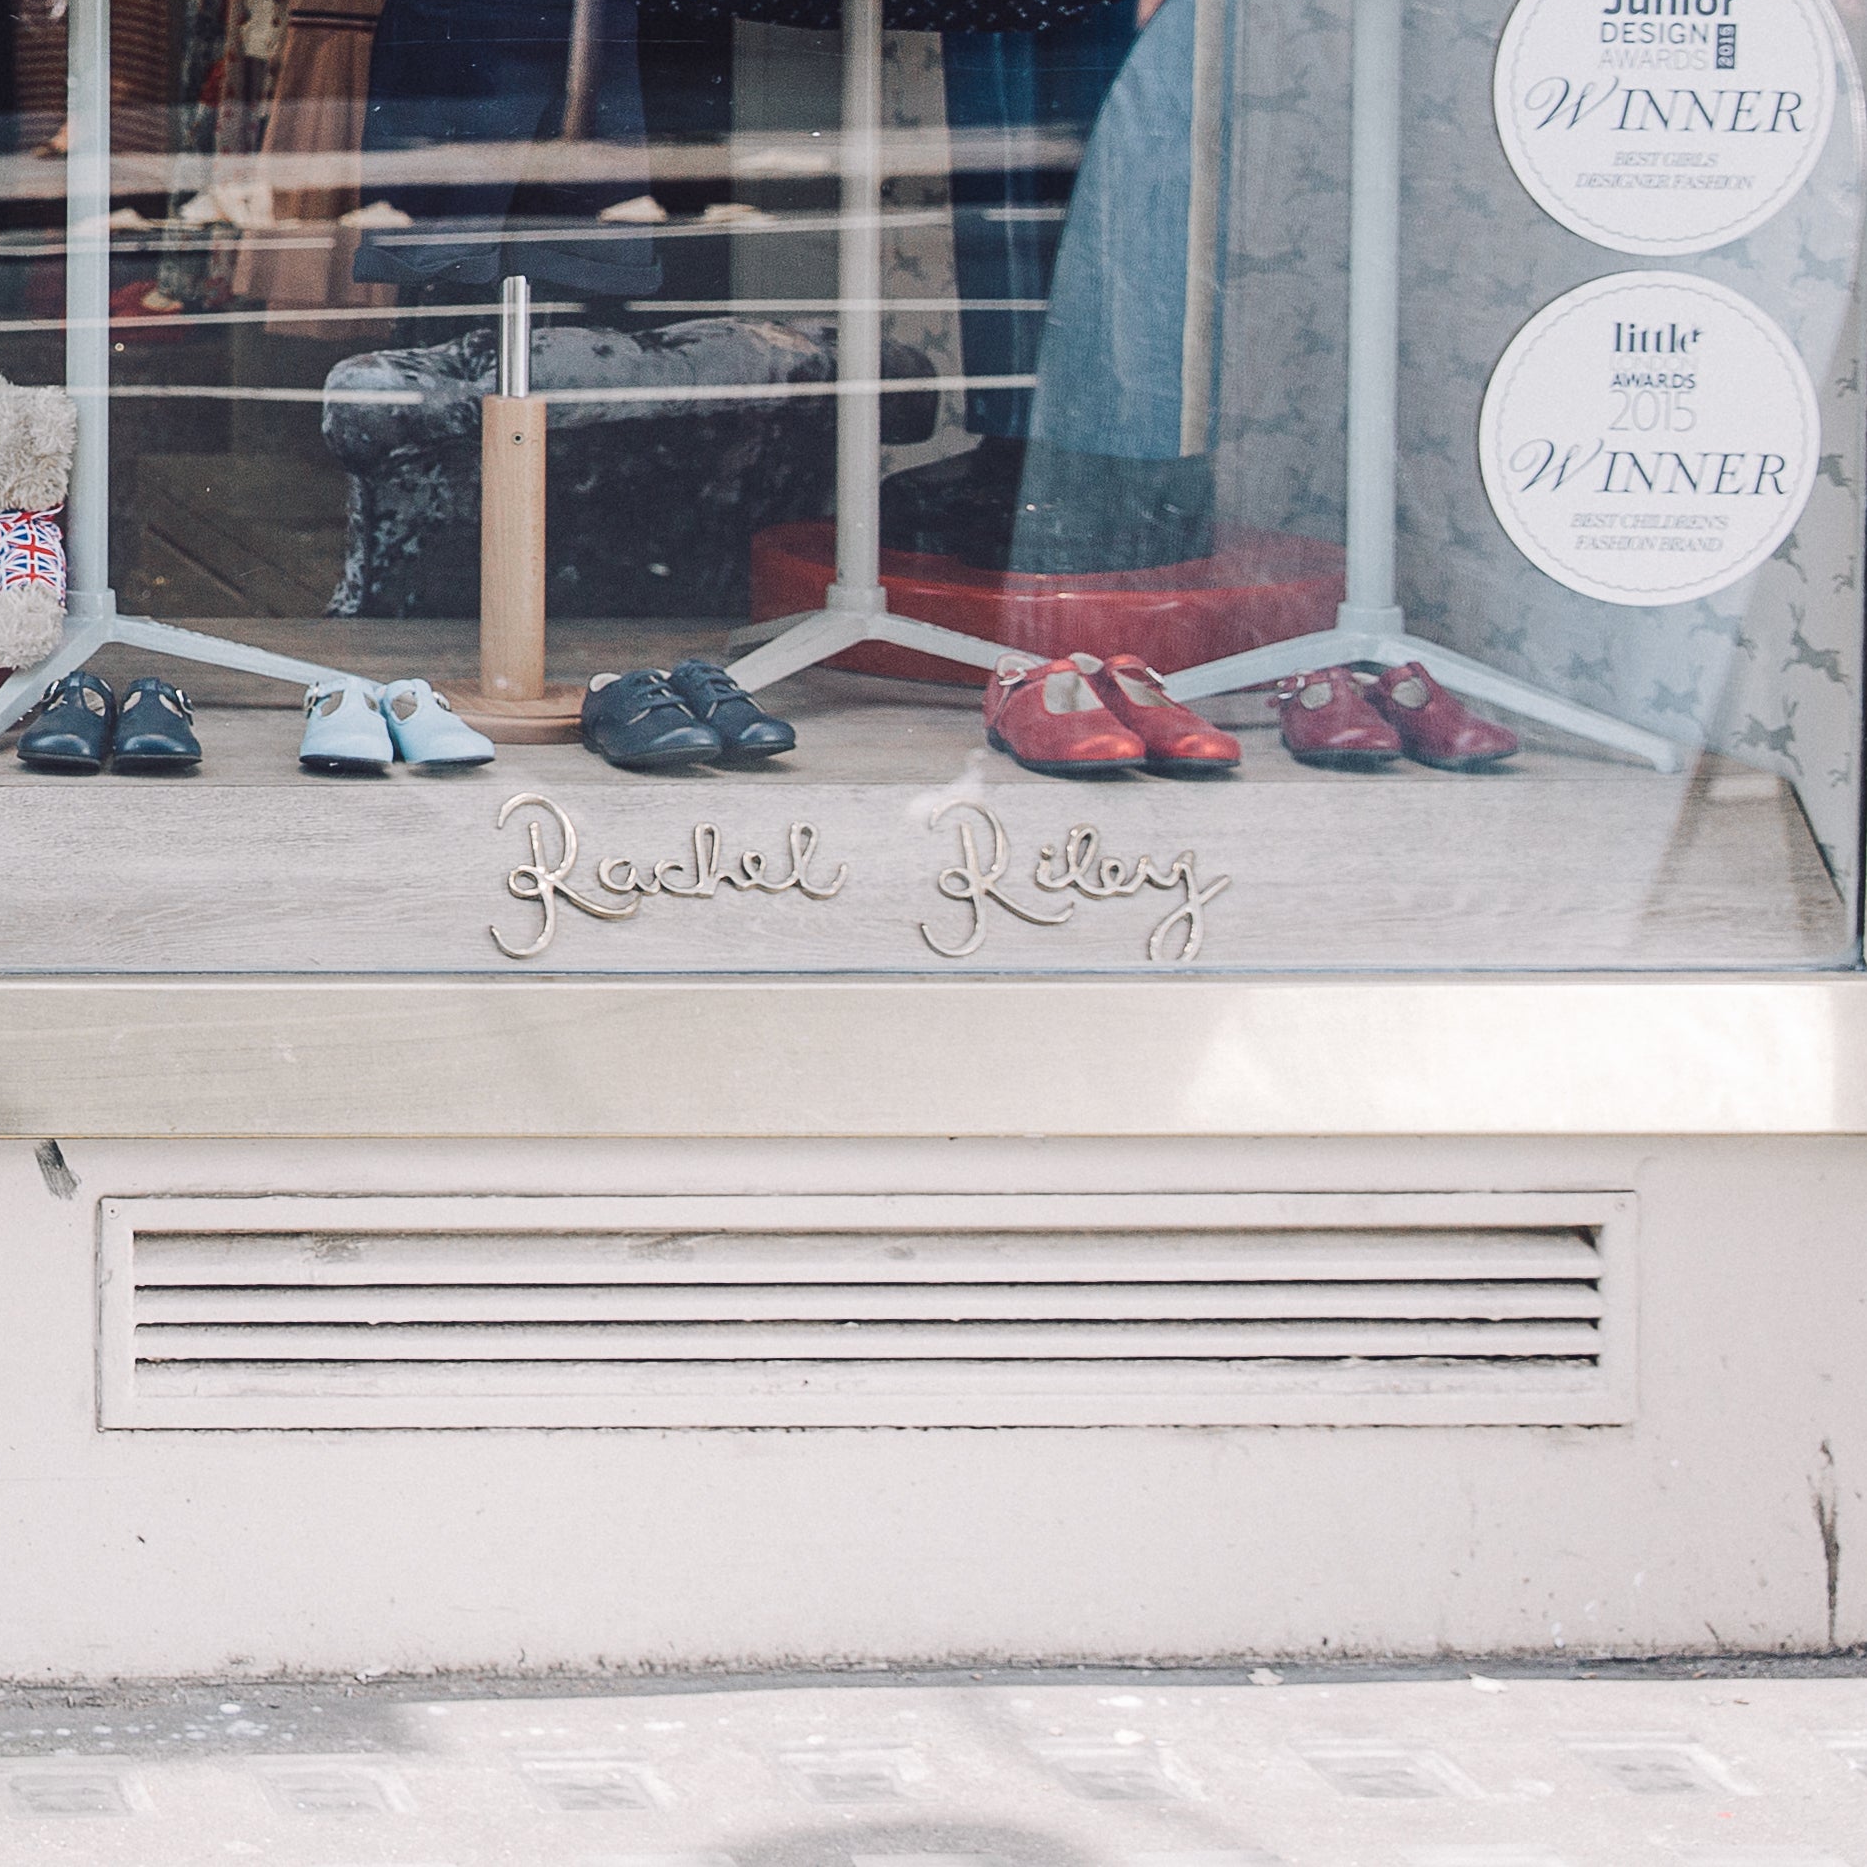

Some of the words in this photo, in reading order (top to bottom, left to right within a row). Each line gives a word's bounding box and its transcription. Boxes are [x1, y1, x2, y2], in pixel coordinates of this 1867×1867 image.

[1600, 21, 1709, 45] DESIGN
[1597, 48, 1707, 70] AWARDS
[1523, 76, 1807, 134] WINNER
[1612, 151, 1662, 167] BEST
[1574, 173, 1670, 189] DESIGNER
[1671, 173, 1756, 189] FASHION
[1612, 373, 1696, 389] AWARDS
[1608, 390, 1697, 433] 2015
[1508, 438, 1788, 496] WINNER
[1570, 512, 1620, 529] BEST
[1575, 535, 1659, 552] FASHION
[1659, 536, 1724, 552] BRAND
[490, 792, 848, 959] Rachel
[920, 799, 1233, 962] Riley
